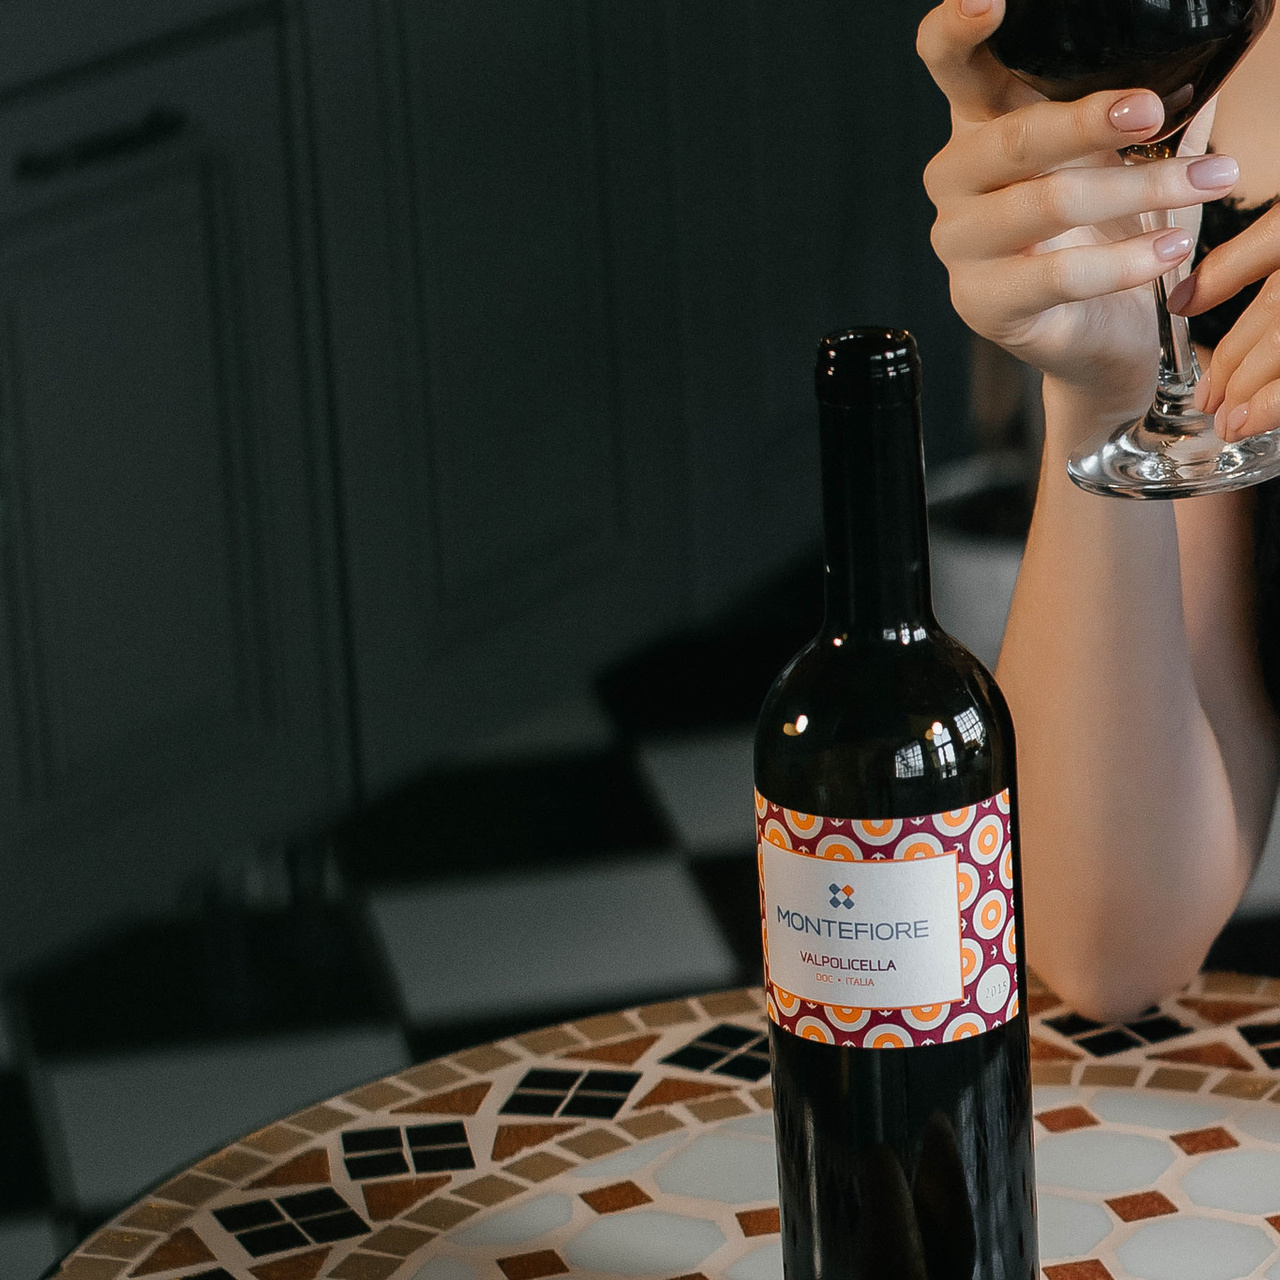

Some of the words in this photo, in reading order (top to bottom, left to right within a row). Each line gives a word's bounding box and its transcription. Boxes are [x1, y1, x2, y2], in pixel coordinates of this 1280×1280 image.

[777, 905, 929, 941] MONTEFIORE
[800, 951, 896, 971] VALPOLICELLA
[816, 973, 834, 983] DOC
[845, 977, 874, 987] ITALIA
[985, 982, 1008, 999] 2015
